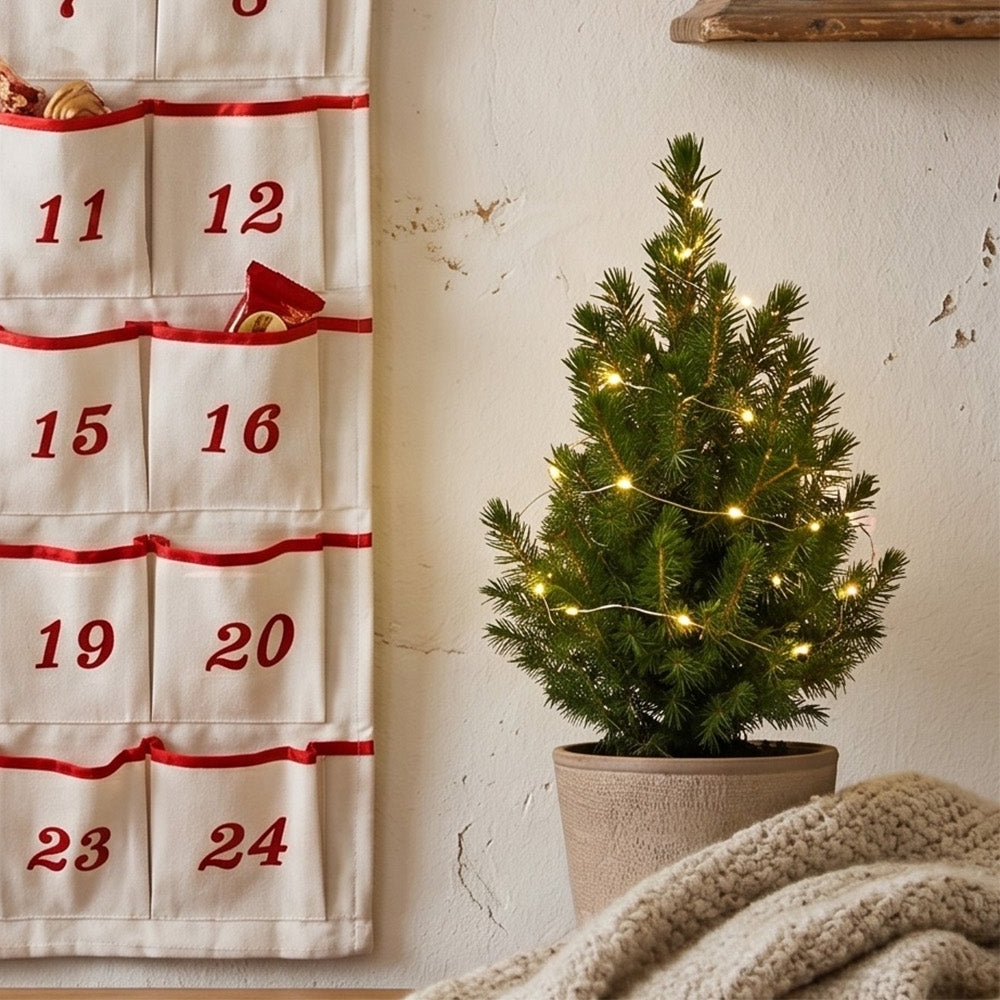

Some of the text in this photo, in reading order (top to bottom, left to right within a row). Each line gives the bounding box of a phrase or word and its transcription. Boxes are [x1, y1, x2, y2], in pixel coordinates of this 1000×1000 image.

[36, 189, 105, 243] 11
[204, 181, 283, 234] 12
[32, 404, 112, 458] 15
[202, 403, 281, 453] 16
[36, 620, 114, 669] 19
[206, 613, 294, 671] 20
[27, 826, 111, 872] 23
[198, 817, 287, 871] 24
